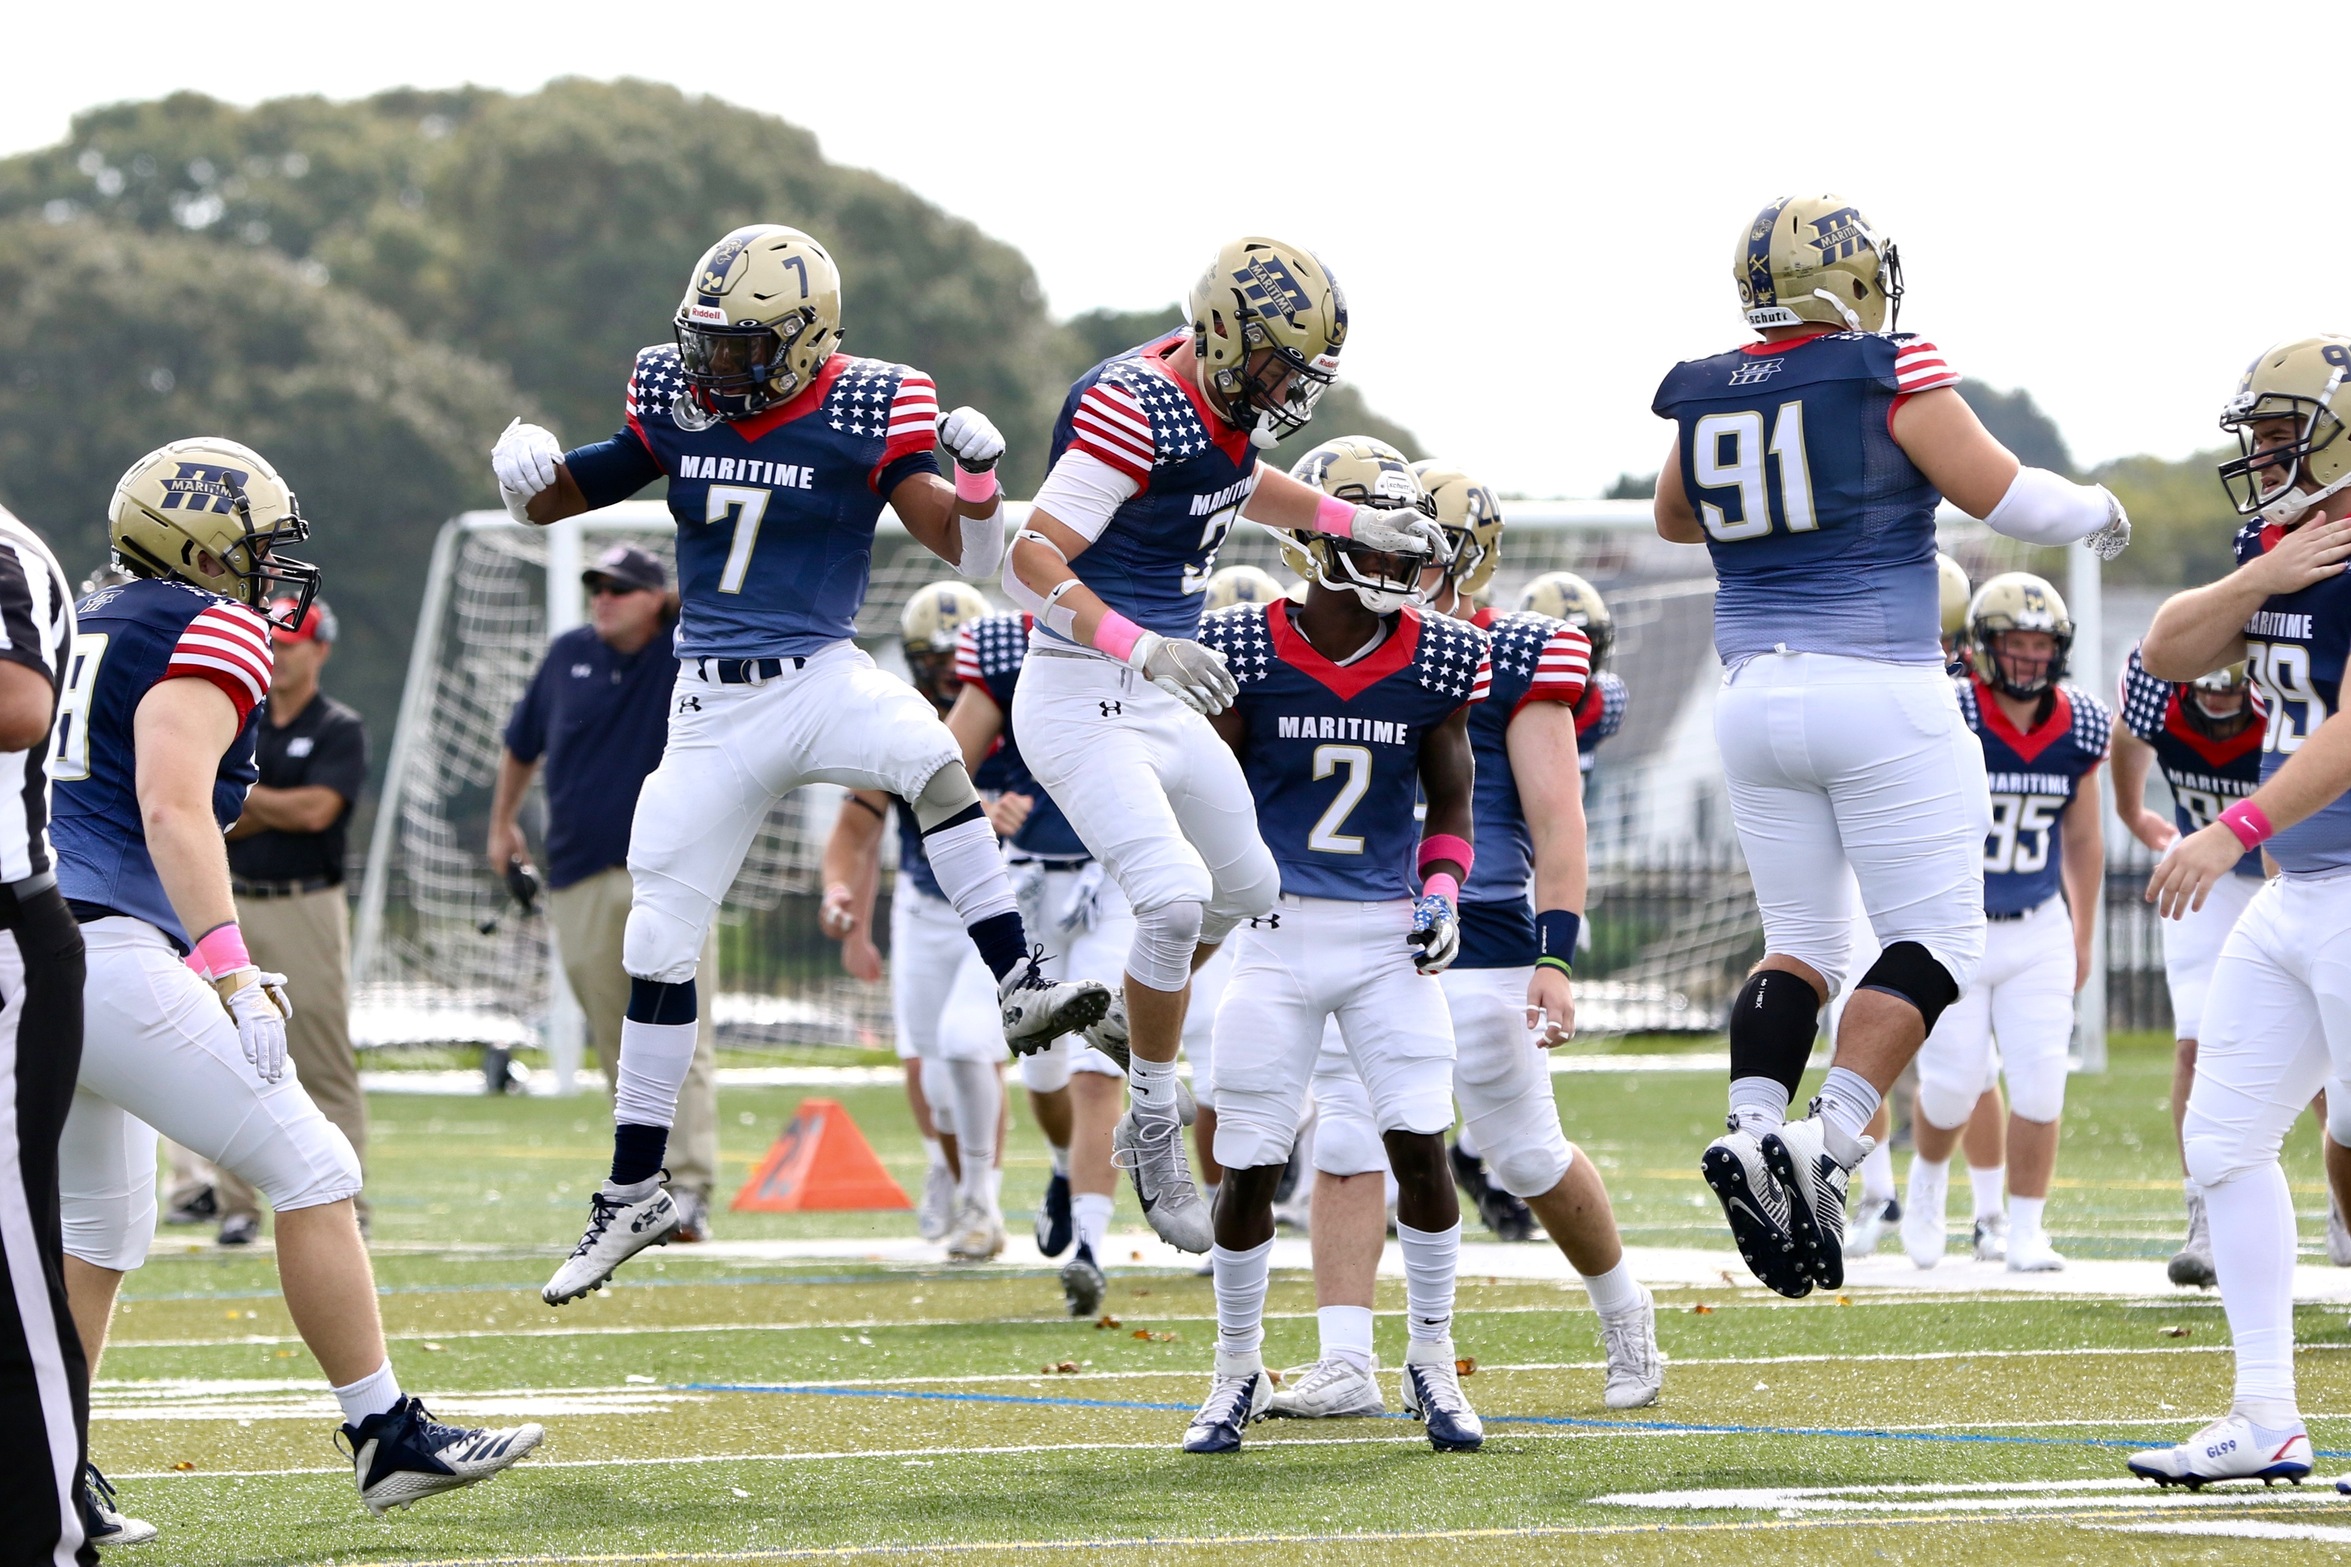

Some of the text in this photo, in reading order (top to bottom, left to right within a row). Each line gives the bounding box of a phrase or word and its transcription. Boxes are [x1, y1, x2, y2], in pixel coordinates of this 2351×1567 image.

[1821, 227, 1857, 248] MARITI
[781, 255, 809, 299] 7
[1250, 263, 1294, 317] MARITIME
[692, 307, 721, 320] Riddell
[1749, 311, 1788, 324] schutt
[2321, 344, 2351, 383] 9
[171, 480, 232, 498] MARITIM
[680, 454, 815, 490] MARITIME
[1692, 400, 1820, 543] 91
[1189, 475, 1254, 516] MARITIM
[706, 484, 772, 595] 7
[1278, 716, 1408, 745] MARITIME
[1308, 744, 1373, 855] 2
[2168, 767, 2260, 797] MARITIM
[2206, 1439, 2238, 1459] GL99
